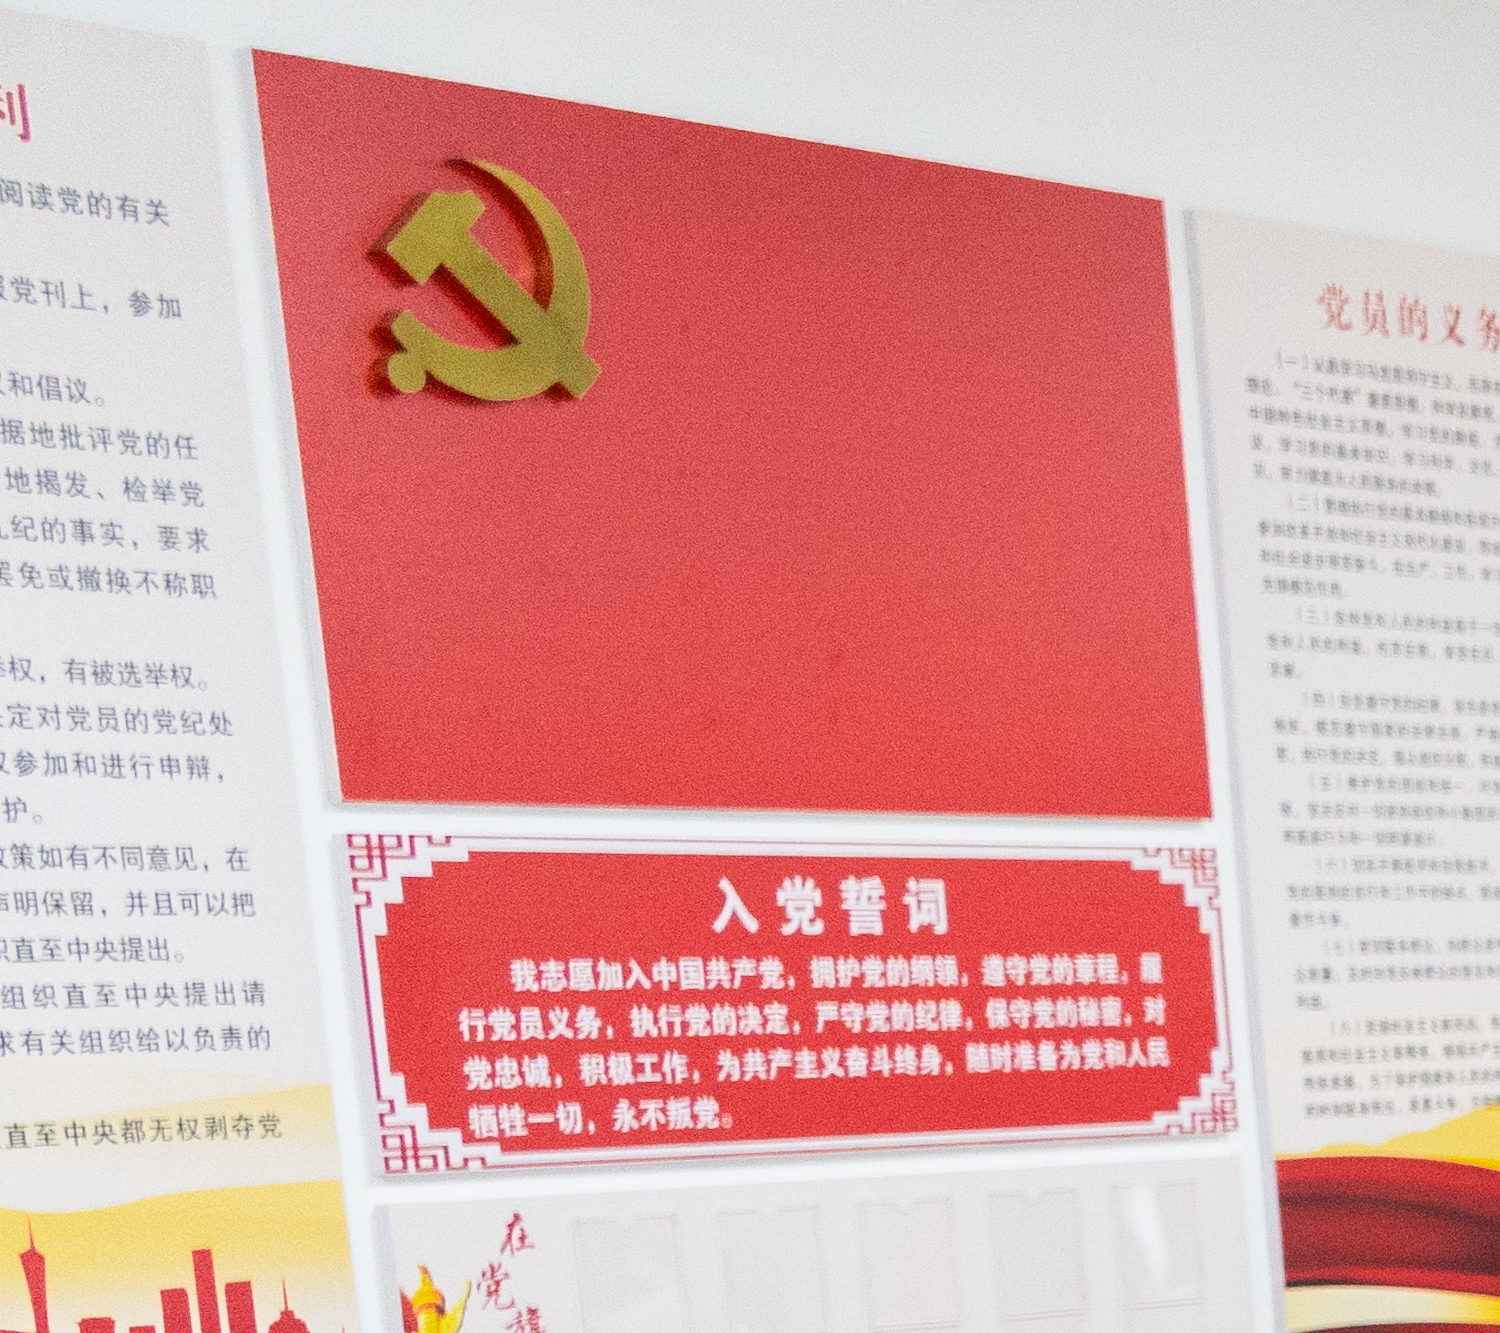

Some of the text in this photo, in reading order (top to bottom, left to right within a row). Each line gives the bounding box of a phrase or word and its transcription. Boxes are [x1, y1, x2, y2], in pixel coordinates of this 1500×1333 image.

[0, 275, 182, 319] 党刊上，参加
[0, 372, 105, 408] 和倡议。
[0, 417, 199, 461] 据地批评党的任
[5, 466, 206, 508] 地揭发、检举党
[0, 514, 211, 554] 纪的事实，要求
[0, 655, 209, 692] 权，有被选举权。
[0, 703, 234, 737] 定对党员的党纪处
[0, 843, 250, 873] 策如有不同意见，在
[712, 874, 949, 937] 入党誓词
[1, 980, 266, 1010] 组织直至中央提出请
[467, 1096, 733, 1139] 牺牲一切，永不叛党。
